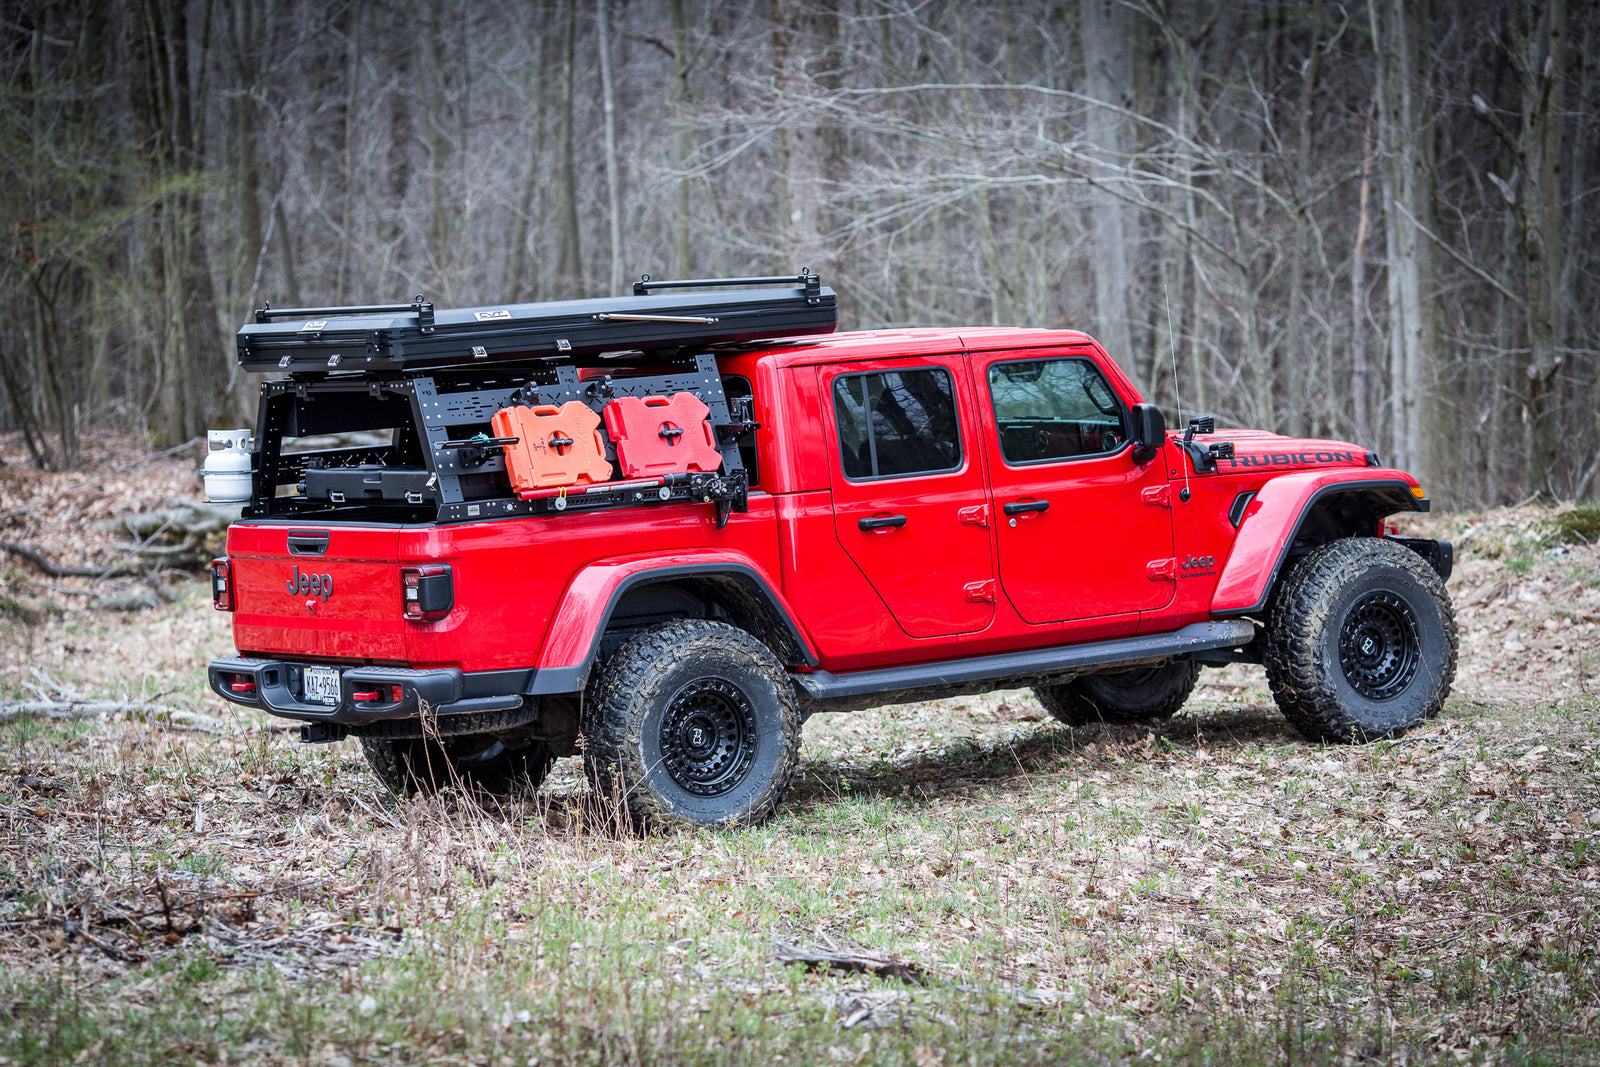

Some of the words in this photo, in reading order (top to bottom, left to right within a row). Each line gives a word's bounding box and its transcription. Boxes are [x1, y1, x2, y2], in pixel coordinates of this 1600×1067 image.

[1230, 451, 1354, 468] RUBICON
[1182, 554, 1215, 571] Jeep
[1180, 570, 1217, 579] GLADIATOR
[287, 566, 333, 602] Jeep
